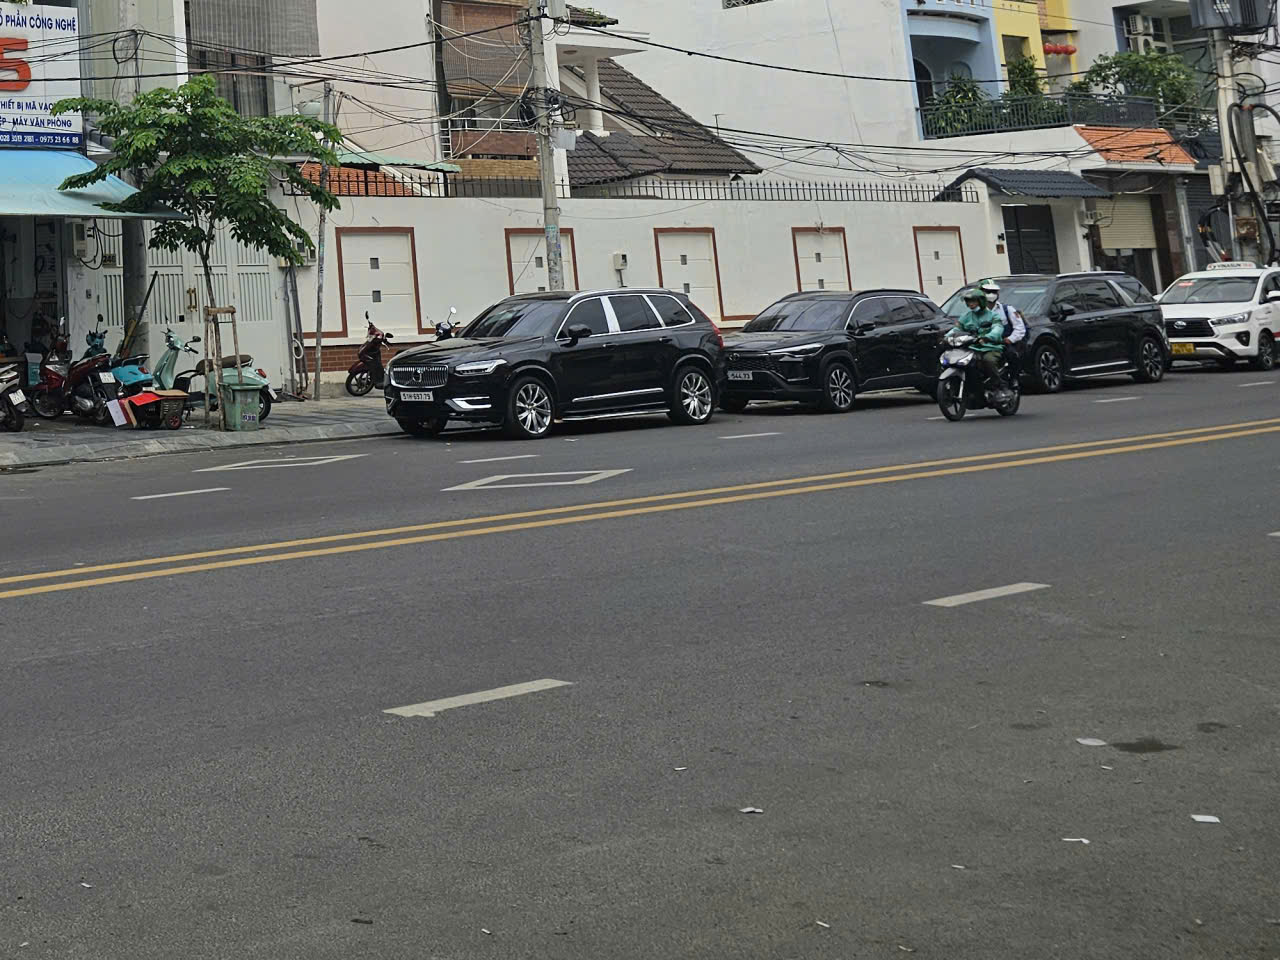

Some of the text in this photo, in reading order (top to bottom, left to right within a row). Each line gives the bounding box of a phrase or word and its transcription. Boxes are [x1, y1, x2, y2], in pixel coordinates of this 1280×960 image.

[29, 14, 53, 30] CÔNG
[55, 17, 77, 33] NGHỆ
[39, 102, 54, 113] VẠC
[30, 117, 45, 127] VĂN
[47, 118, 72, 128] PHÒNG
